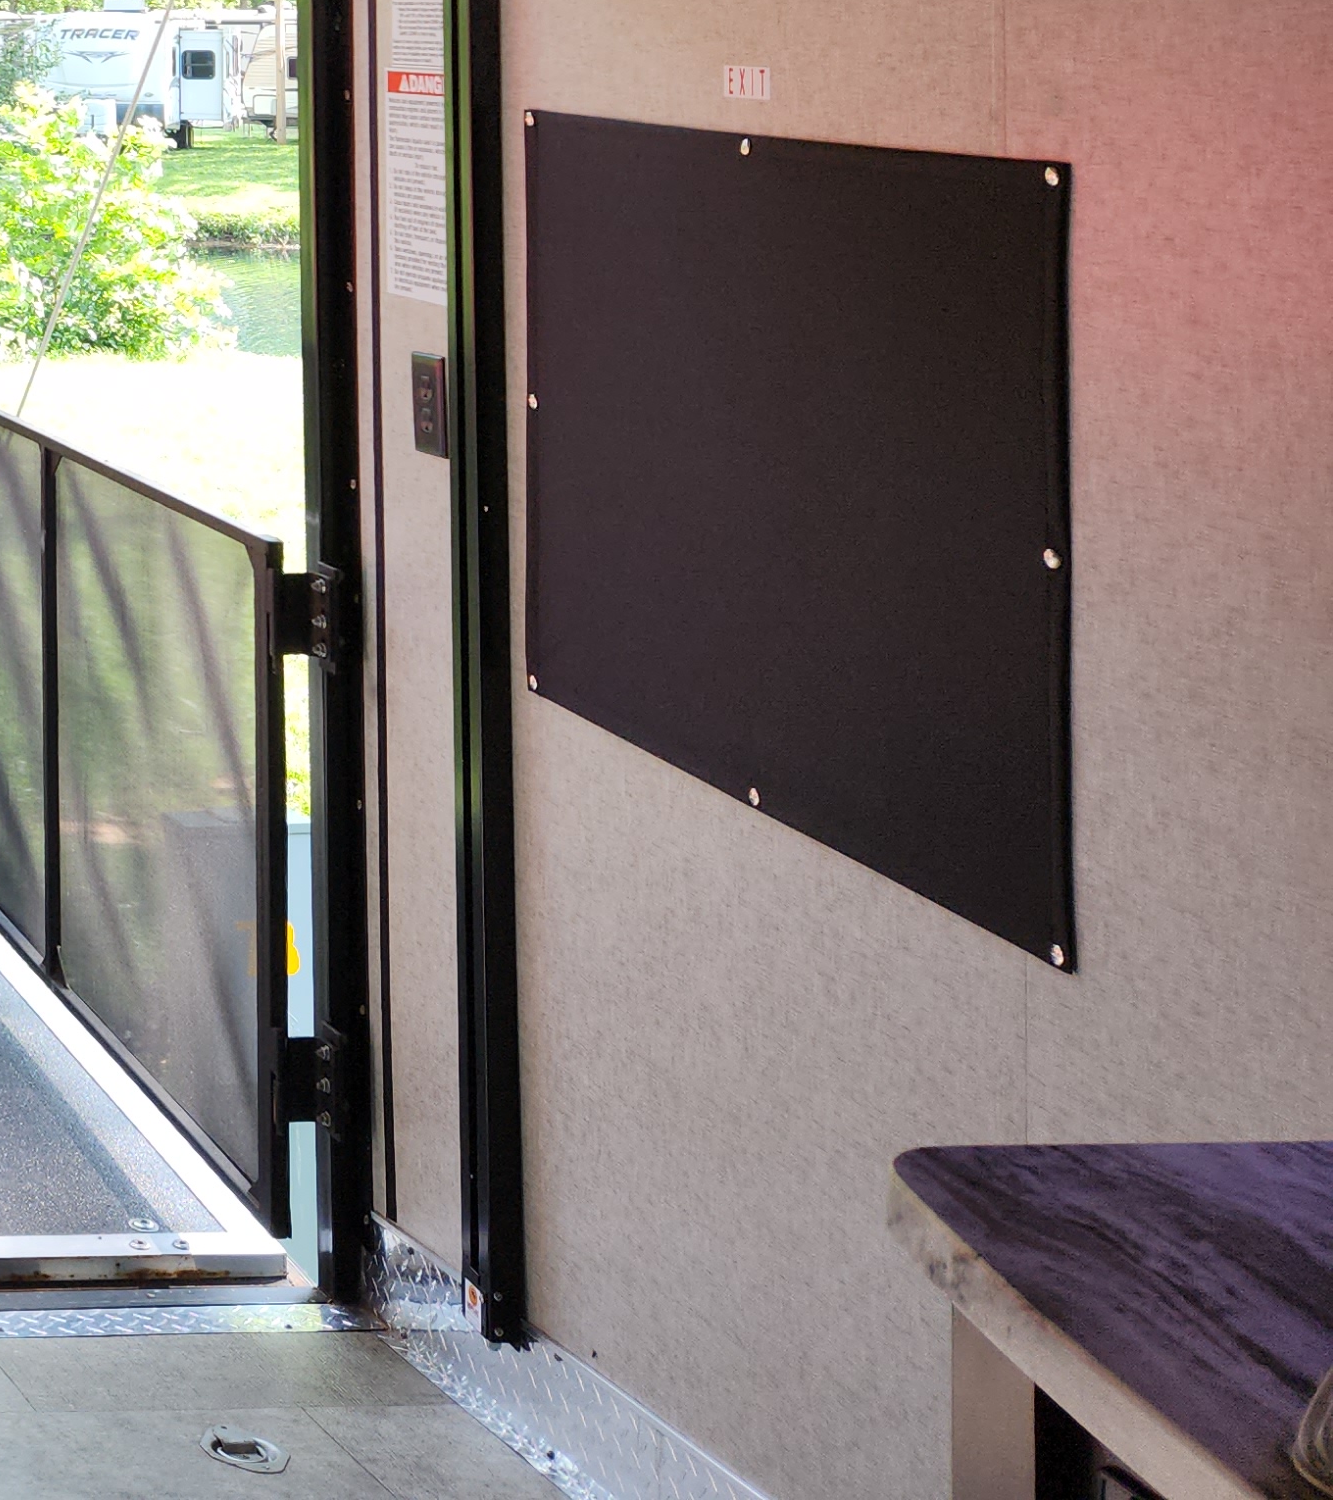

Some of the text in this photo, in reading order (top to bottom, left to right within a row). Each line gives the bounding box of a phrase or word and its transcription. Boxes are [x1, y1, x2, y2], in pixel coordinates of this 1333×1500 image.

[60, 28, 140, 41] TRACER
[408, 74, 445, 96] DANG
[728, 67, 766, 97] EXIT
